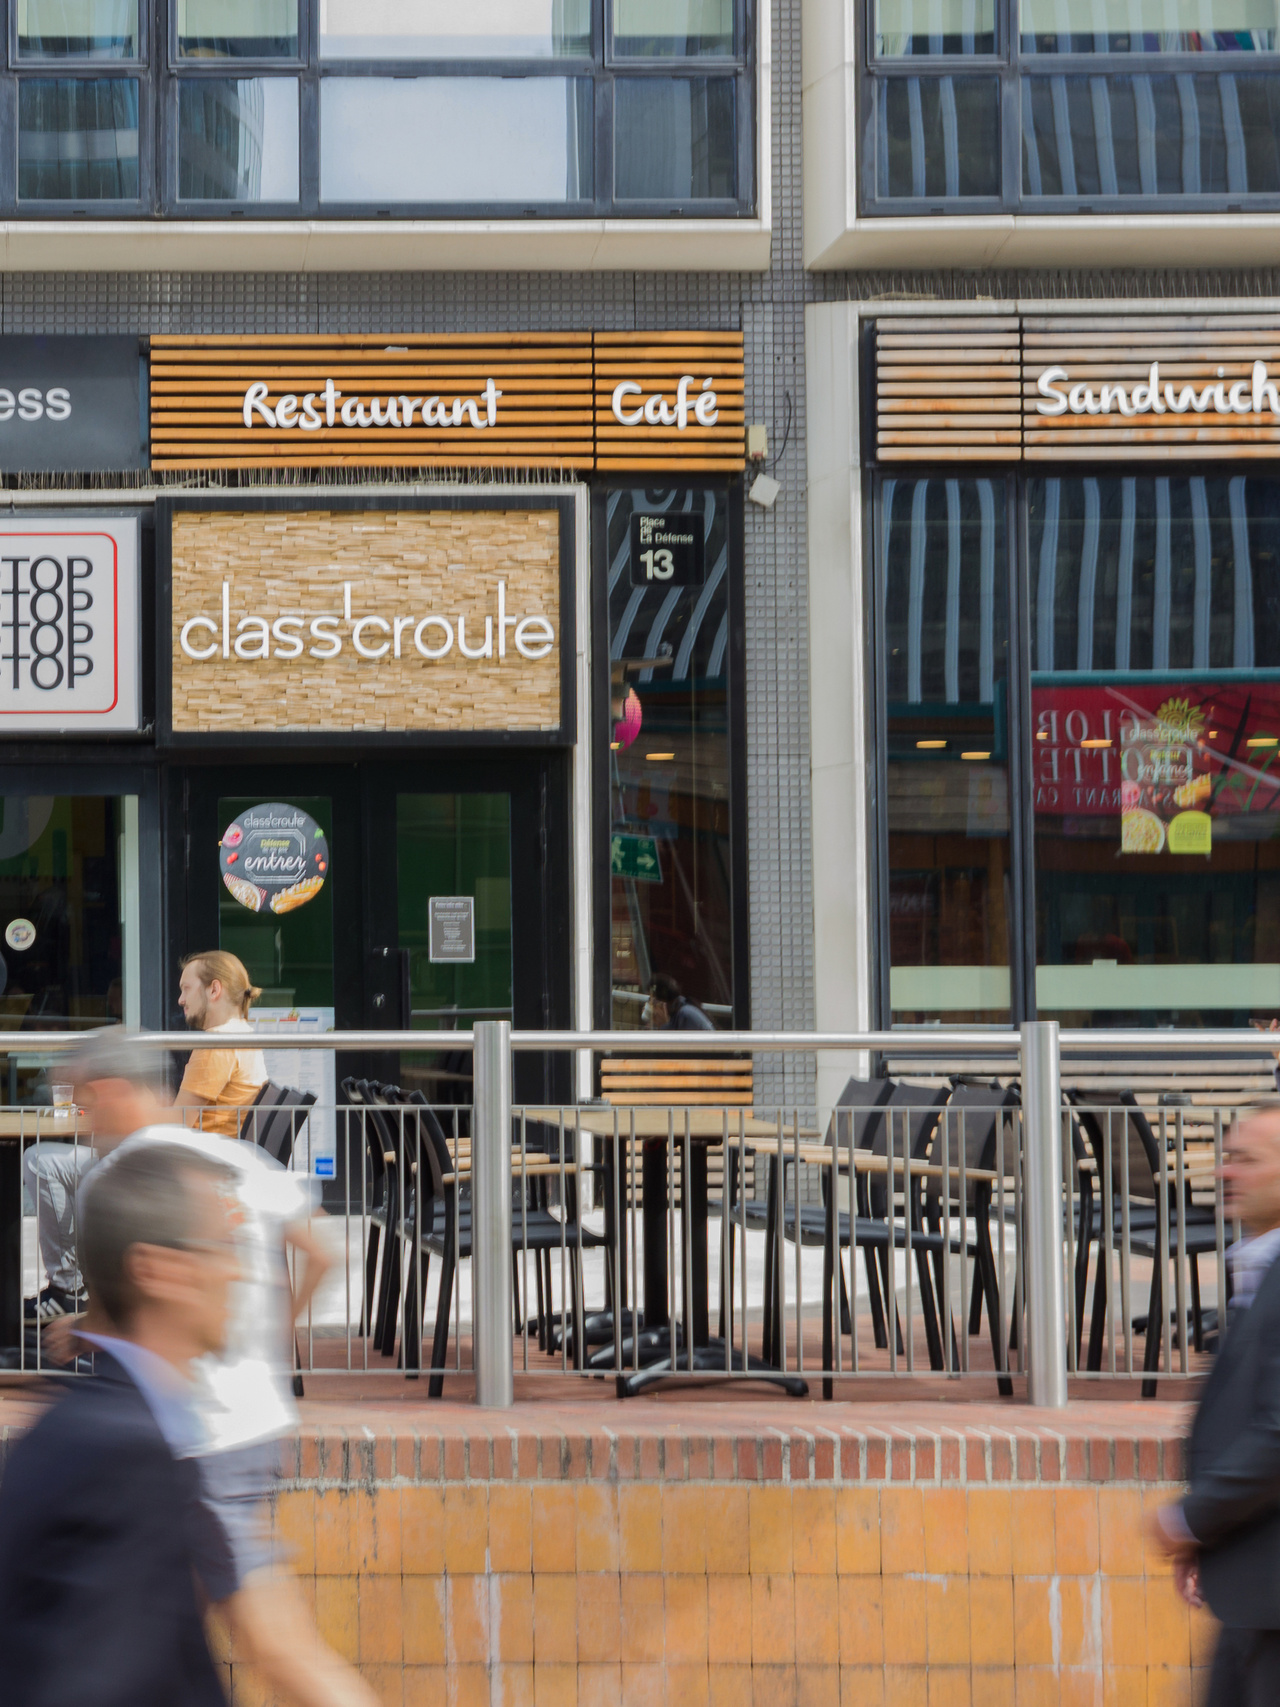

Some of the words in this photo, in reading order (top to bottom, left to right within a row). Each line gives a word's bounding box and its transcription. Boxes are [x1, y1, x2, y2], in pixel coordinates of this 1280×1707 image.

[242, 378, 503, 431] Restaurant
[612, 375, 720, 431] Café
[1036, 361, 1280, 417] Sandwich
[640, 516, 666, 528] Place
[640, 533, 653, 545] La
[655, 532, 694, 545] Défense
[640, 548, 675, 581] 13
[179, 580, 555, 660] class'croute
[244, 852, 307, 871] entrer
